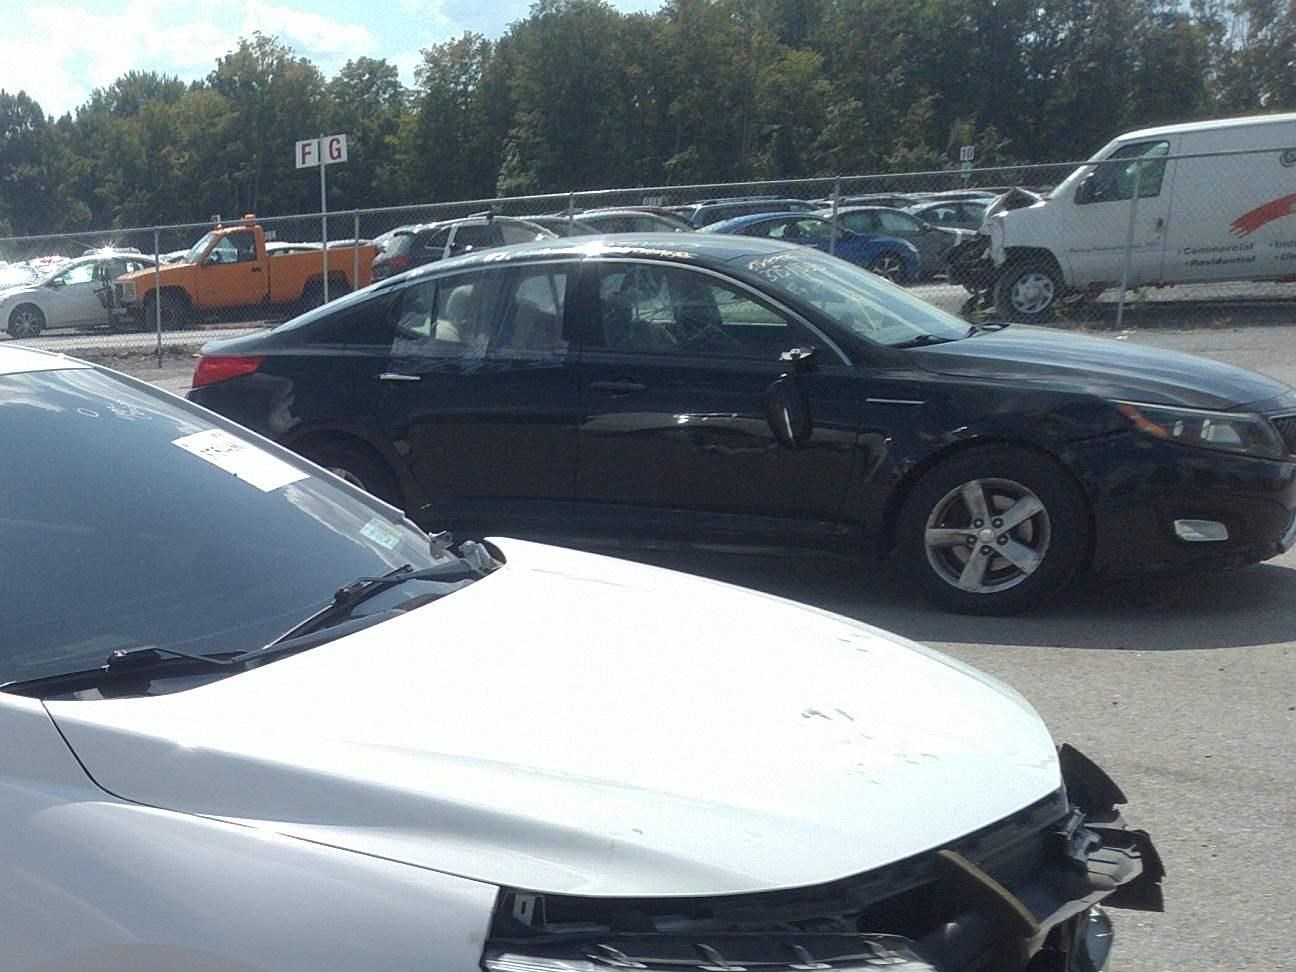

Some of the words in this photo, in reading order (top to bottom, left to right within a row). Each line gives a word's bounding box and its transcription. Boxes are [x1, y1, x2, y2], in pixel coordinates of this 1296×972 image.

[301, 143, 312, 165] F
[329, 138, 342, 160] G
[962, 148, 973, 158] 10
[1184, 243, 1253, 255] Commercial
